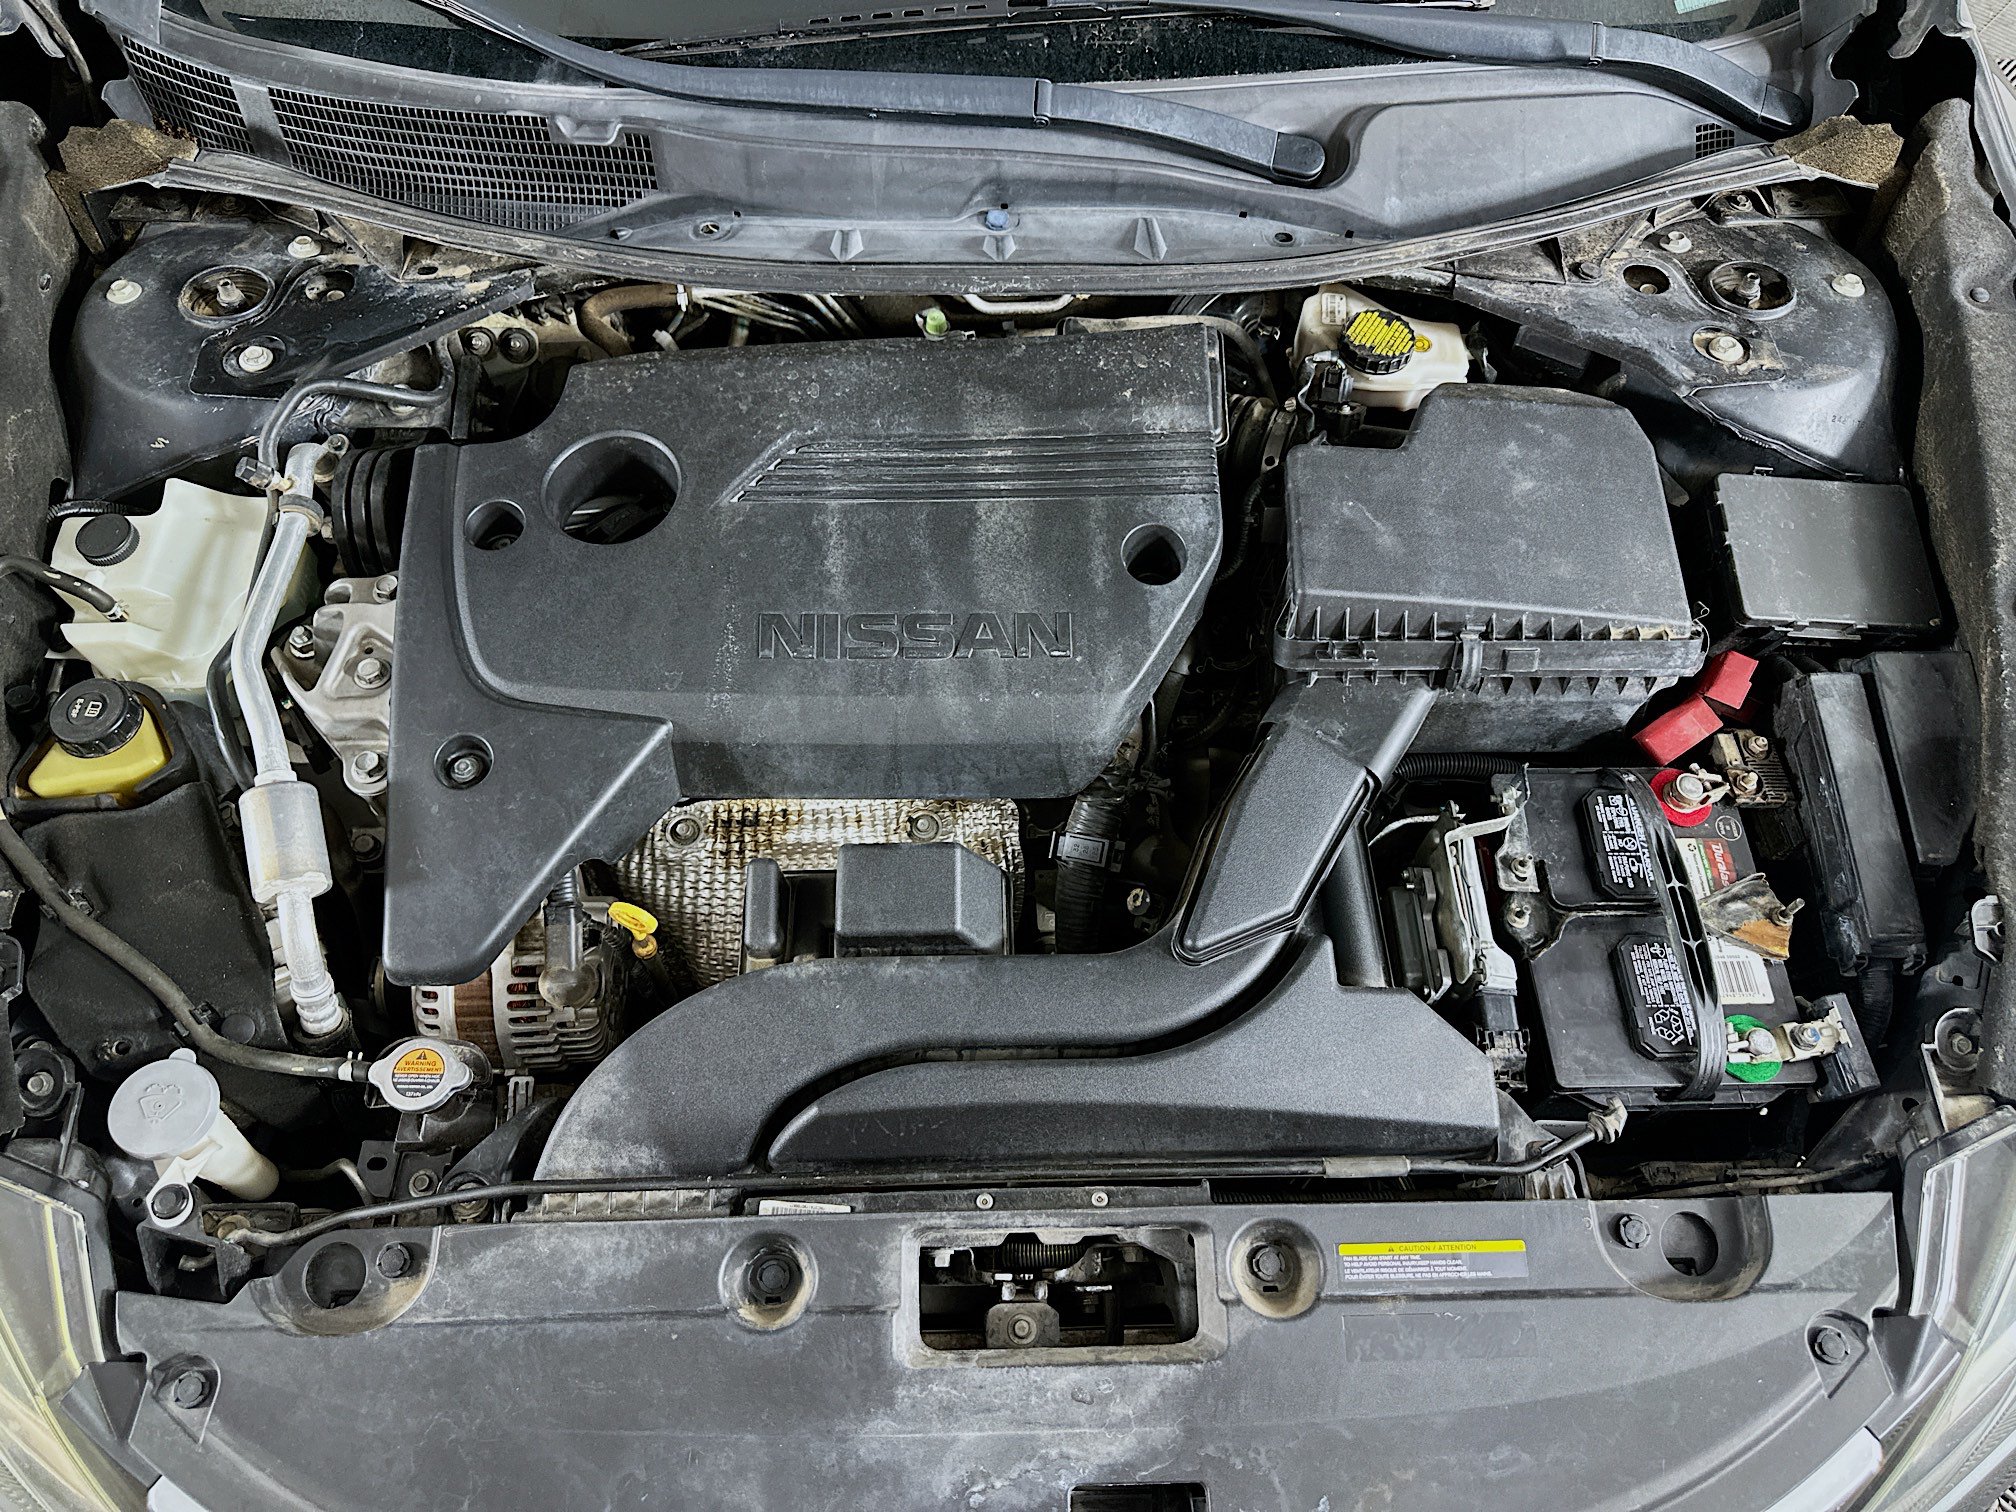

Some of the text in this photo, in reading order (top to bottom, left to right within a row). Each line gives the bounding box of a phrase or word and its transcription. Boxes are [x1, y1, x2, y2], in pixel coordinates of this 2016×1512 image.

[758, 612, 1073, 660] NISSAN
[71, 698, 84, 718] E-PSF
[1711, 842, 1730, 887] Duralas
